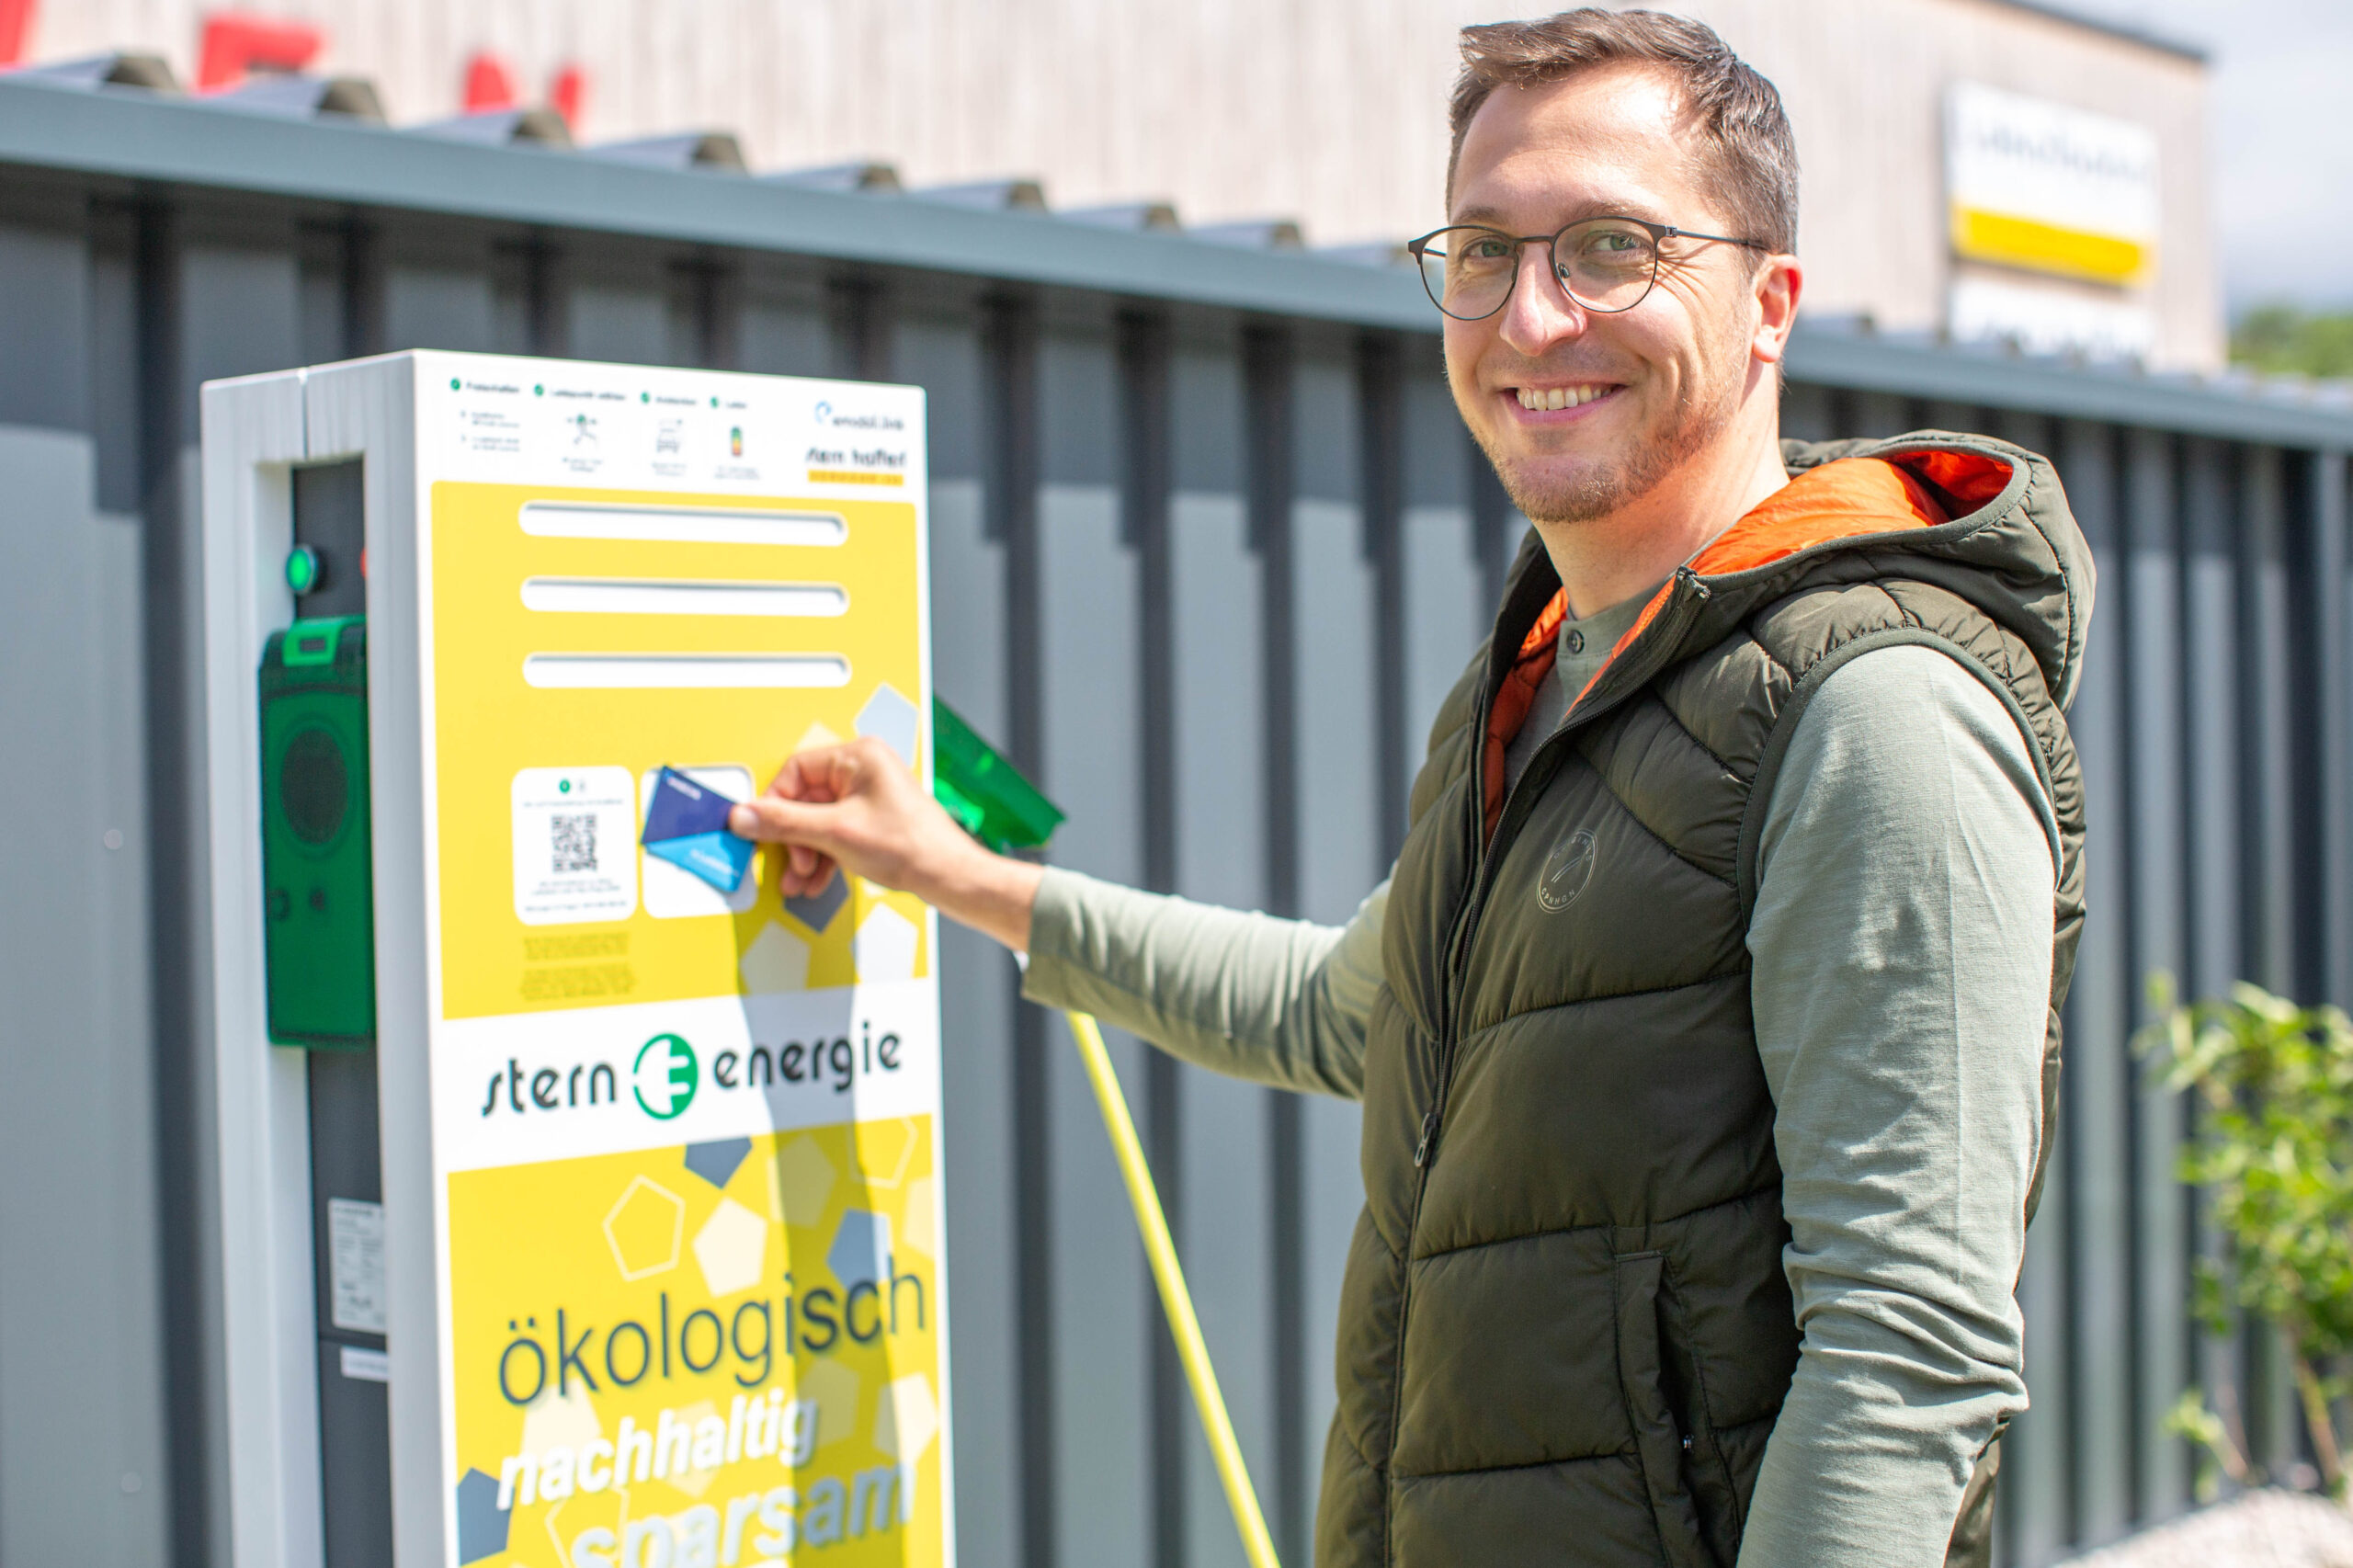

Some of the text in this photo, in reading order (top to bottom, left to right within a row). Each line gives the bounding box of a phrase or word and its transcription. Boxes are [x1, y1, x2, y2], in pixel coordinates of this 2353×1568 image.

[482, 1019, 902, 1118] stern energie
[498, 1253, 926, 1406] ökologisch
[496, 1388, 819, 1510] nachhaltig
[571, 1462, 917, 1568] sparsam
